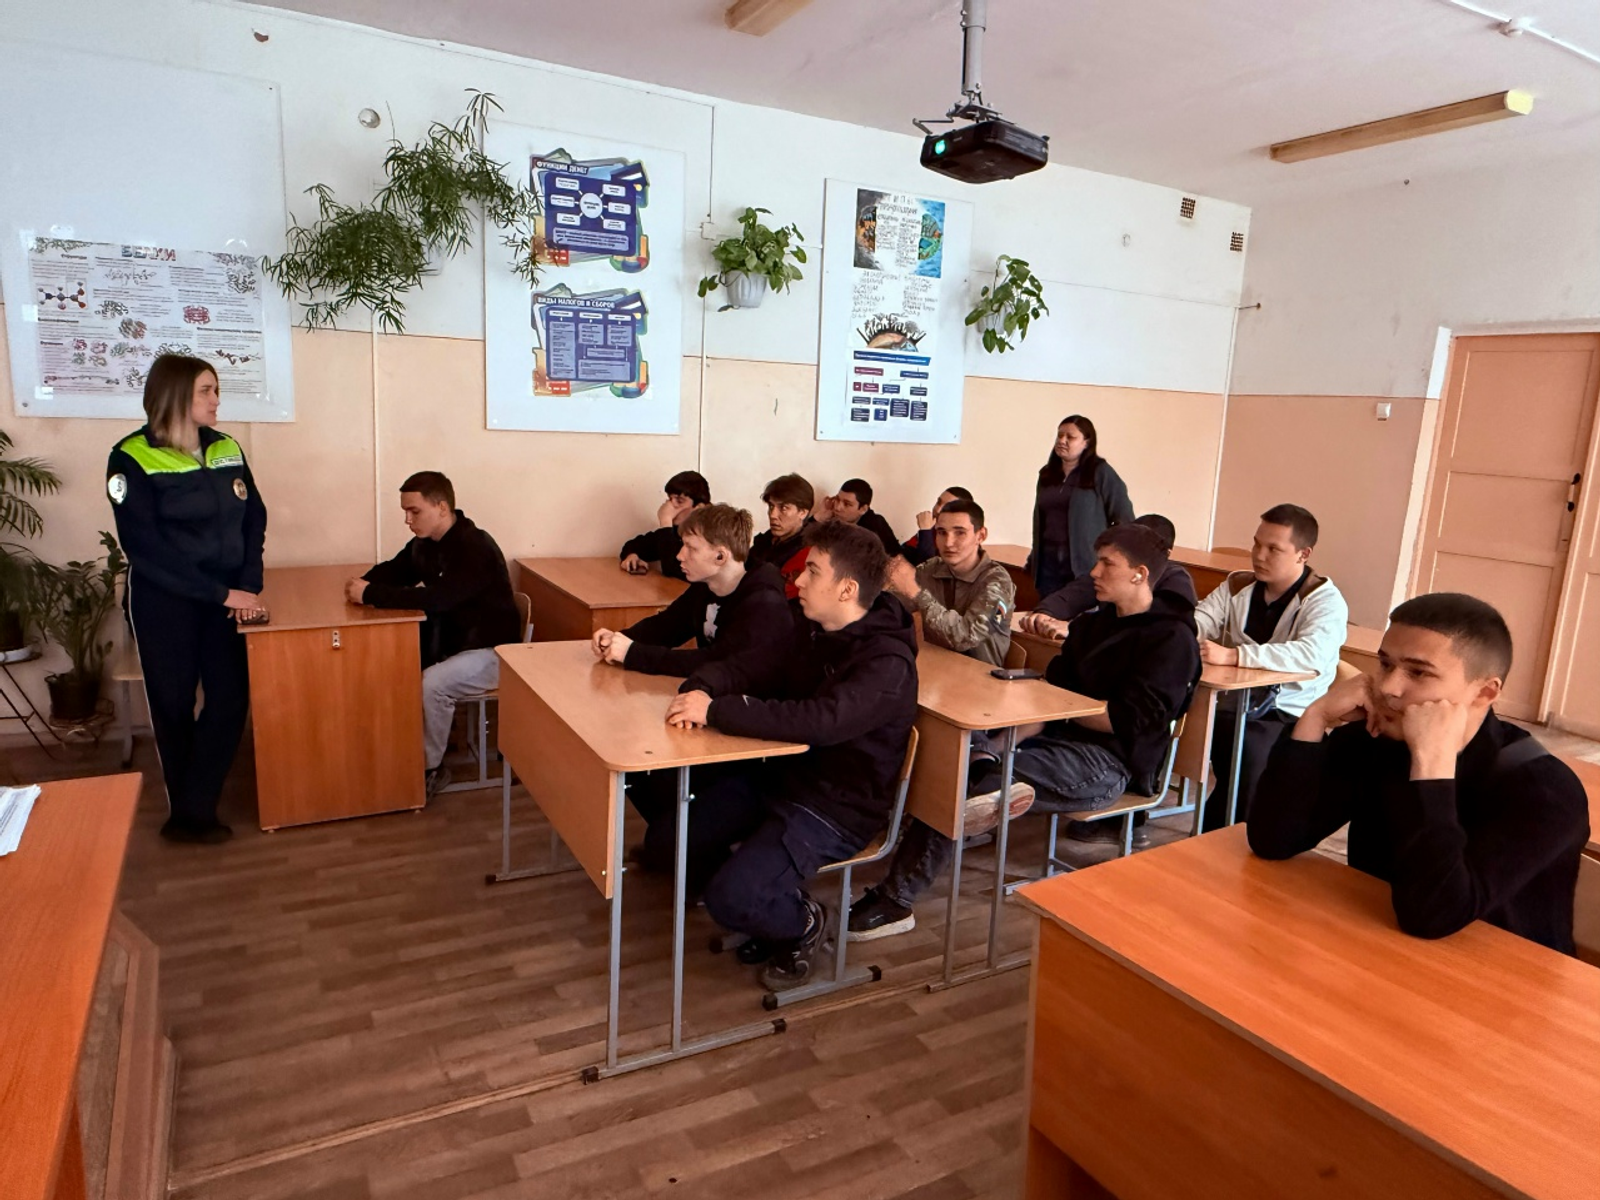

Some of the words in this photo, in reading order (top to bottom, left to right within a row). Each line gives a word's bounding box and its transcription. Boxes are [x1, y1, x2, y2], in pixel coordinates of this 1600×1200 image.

[536, 161, 568, 171] ФУНКЦИИ
[569, 165, 588, 174] ДЕНЕГ
[558, 298, 585, 307] НАЛОГОВ
